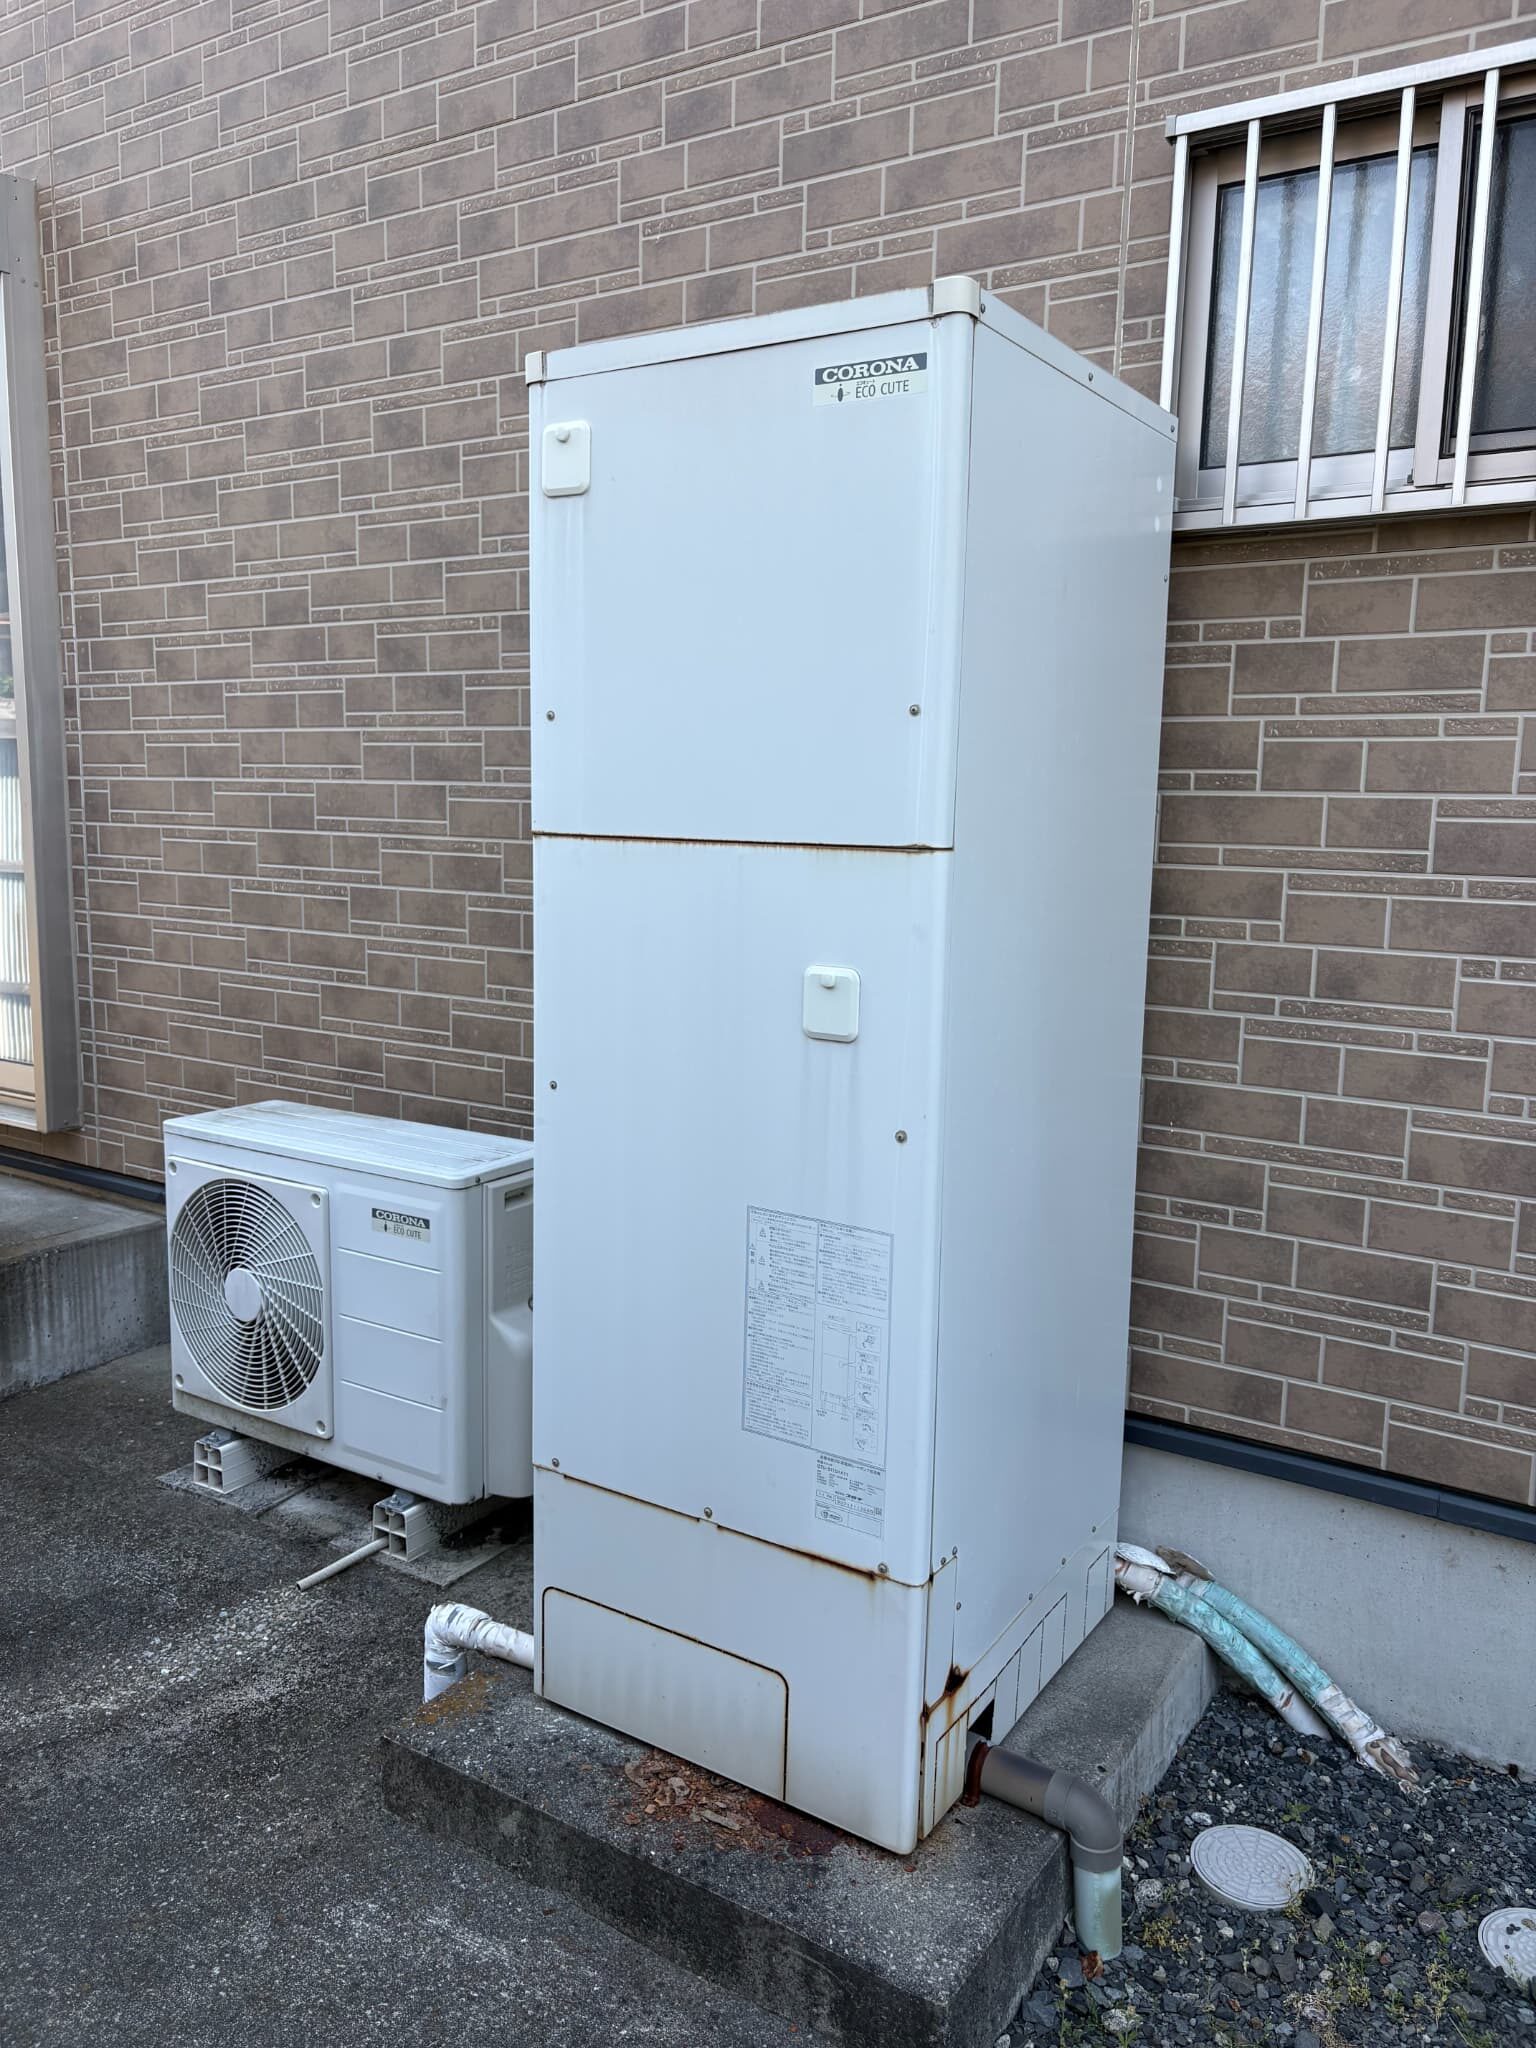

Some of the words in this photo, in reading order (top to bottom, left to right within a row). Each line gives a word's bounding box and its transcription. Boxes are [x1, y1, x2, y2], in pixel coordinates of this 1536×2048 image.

[822, 356, 920, 383] CORONA
[855, 384, 876, 399] ECO
[880, 380, 910, 395] CUTE
[375, 1210, 426, 1228] CORONA
